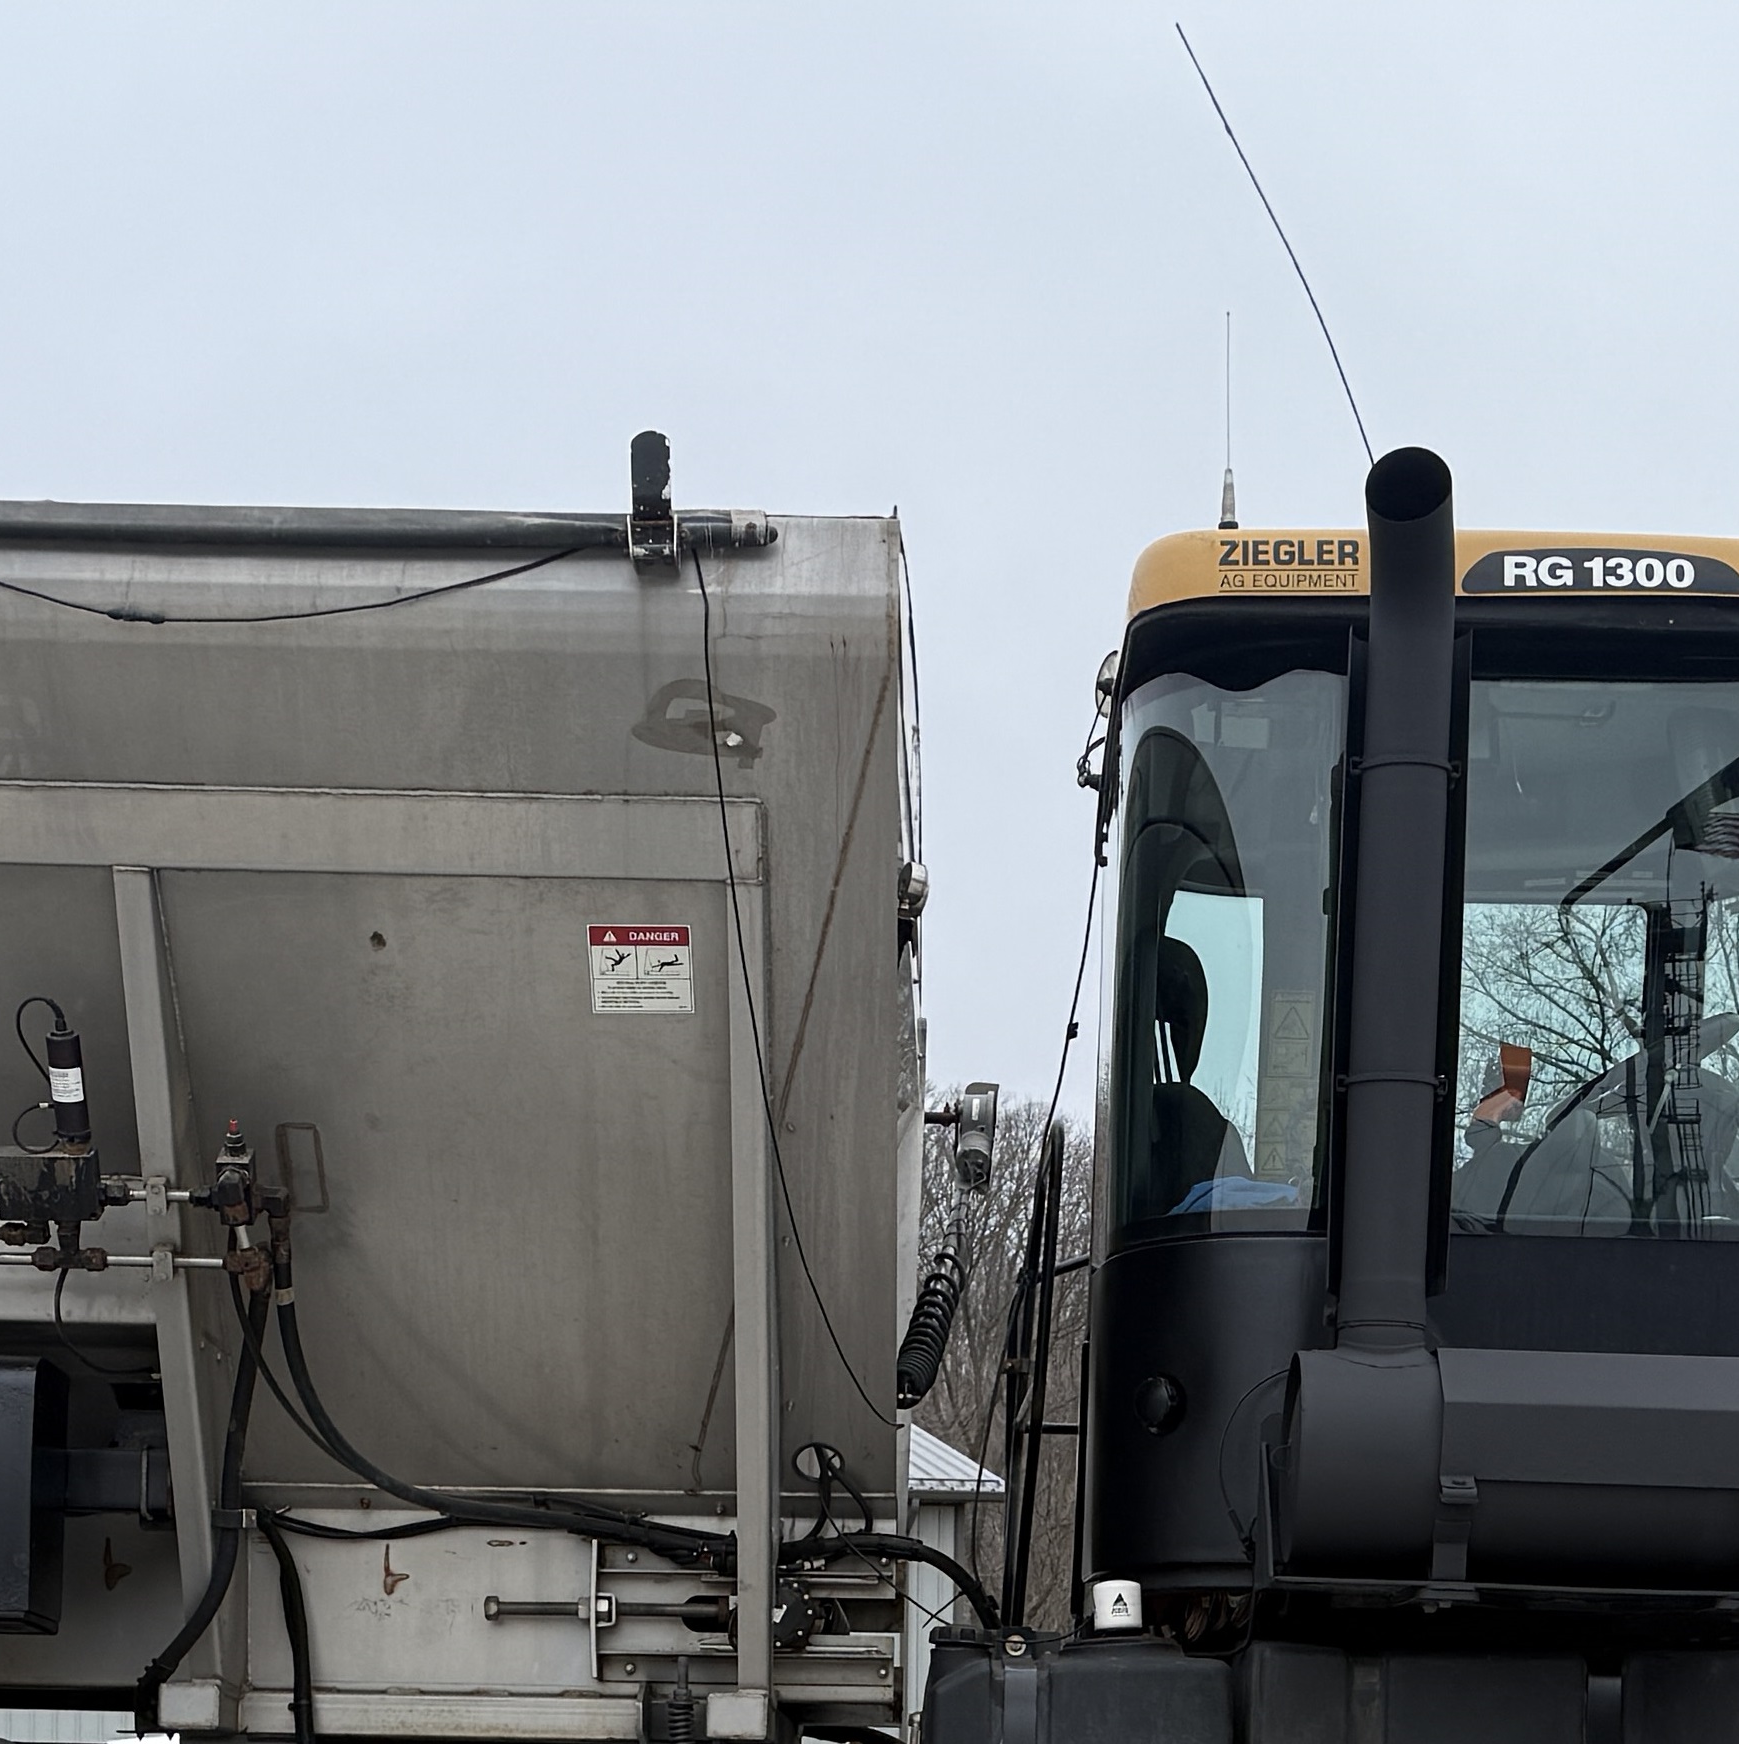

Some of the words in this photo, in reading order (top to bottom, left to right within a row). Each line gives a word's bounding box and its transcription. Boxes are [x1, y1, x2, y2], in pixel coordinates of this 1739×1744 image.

[1218, 539, 1359, 566] ZIEGLER
[1220, 573, 1245, 588] AG
[1252, 573, 1358, 588] EQUIPMENT
[1503, 556, 1574, 587] RG
[1583, 556, 1695, 588] 1300
[629, 931, 679, 942] DANGER
